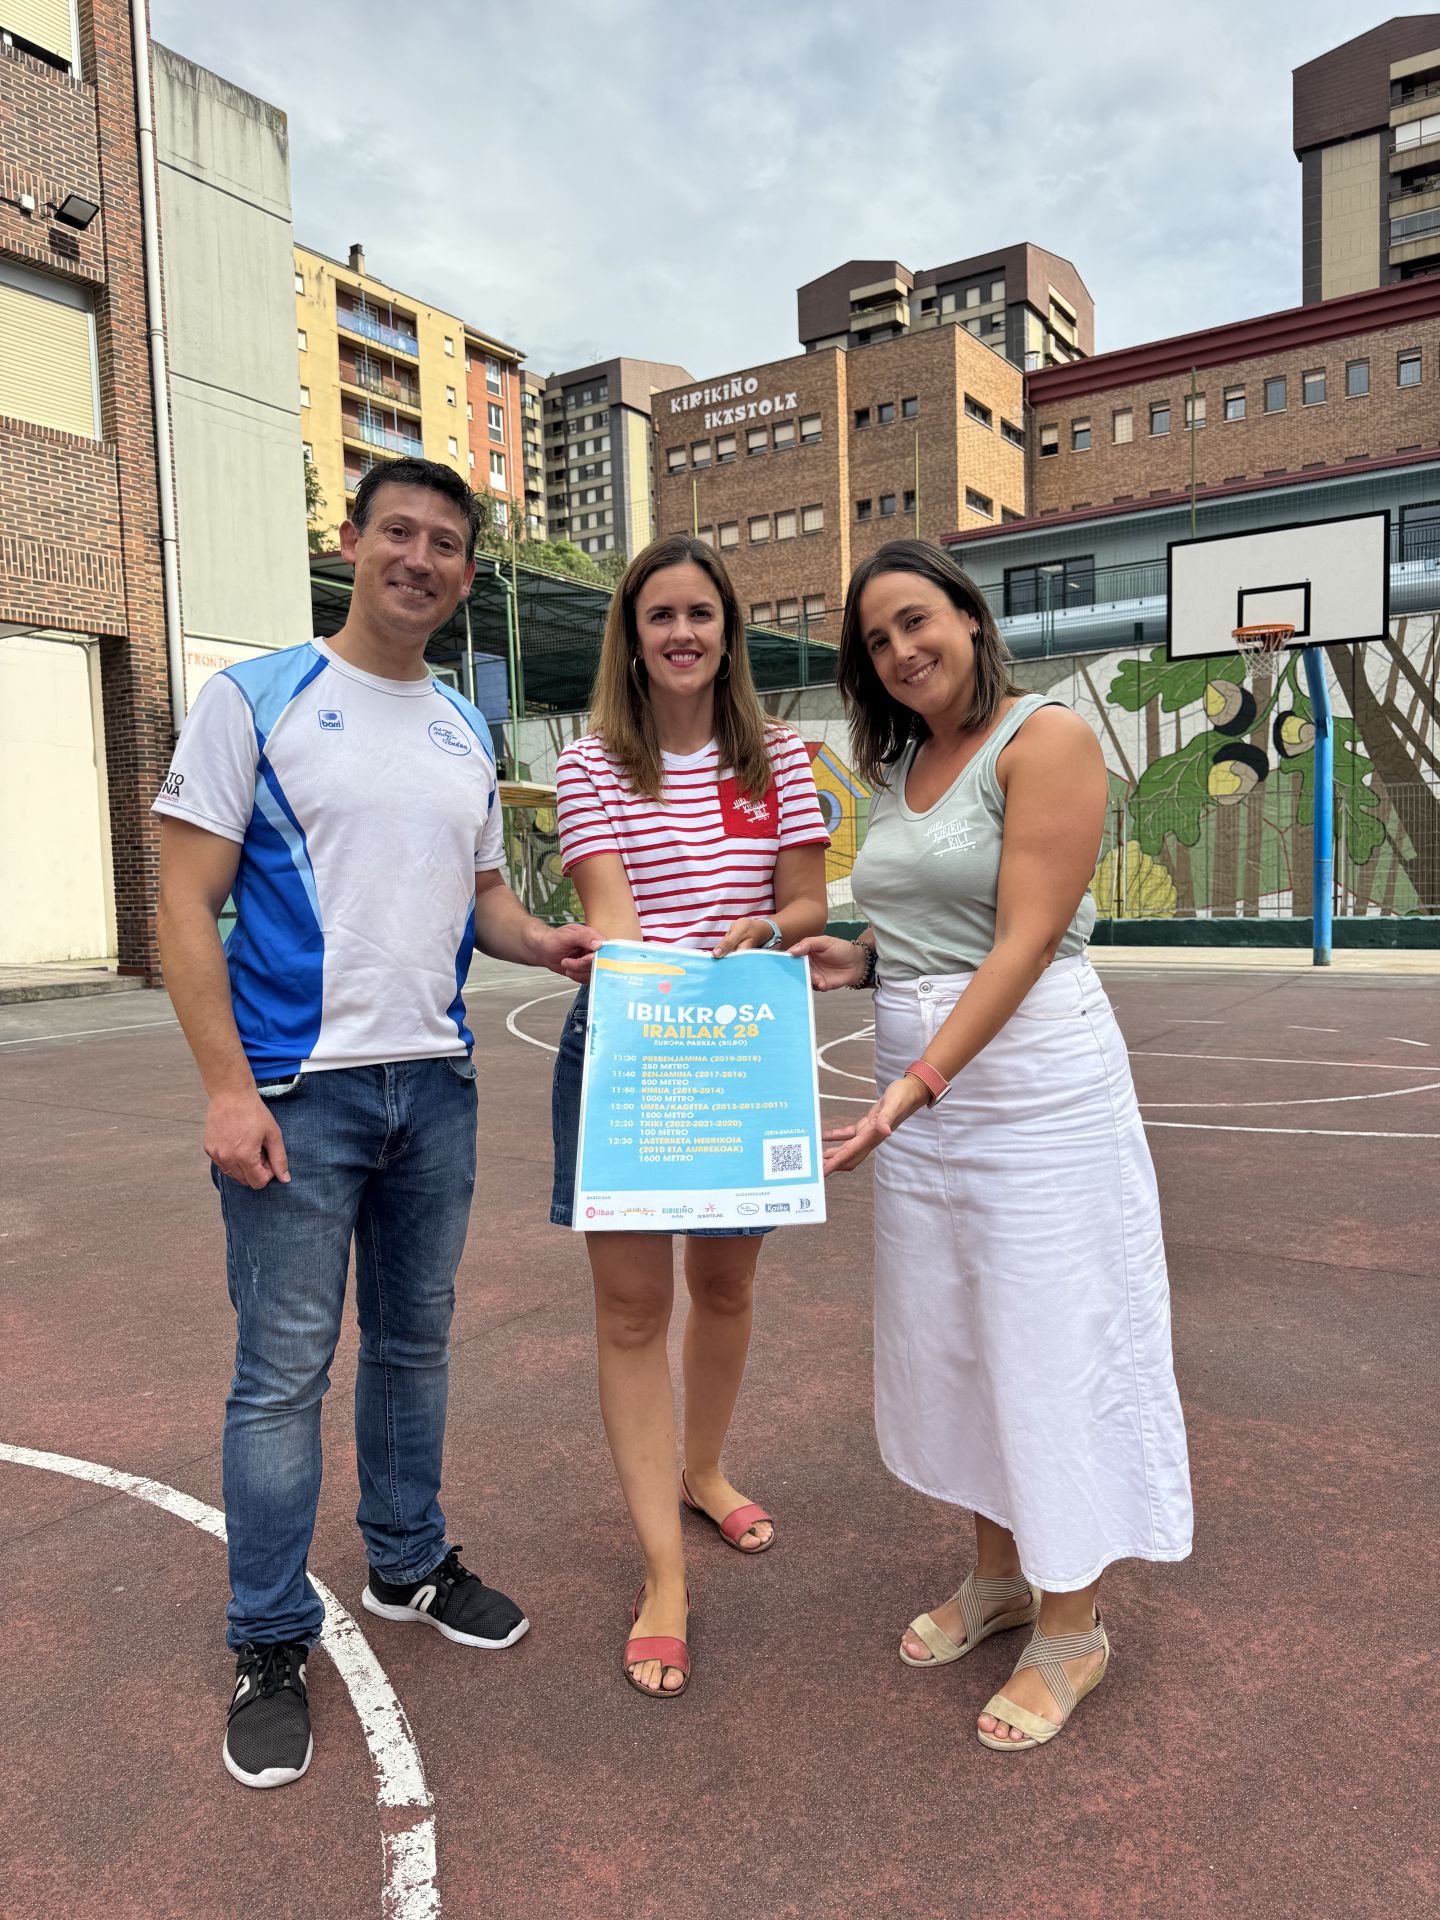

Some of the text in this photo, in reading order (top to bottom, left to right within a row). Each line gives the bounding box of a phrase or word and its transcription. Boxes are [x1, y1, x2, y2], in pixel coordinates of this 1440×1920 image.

[627, 1002, 775, 1025] IBILKROSA
[642, 1024, 760, 1039] IRAILAK 28
[718, 1039, 748, 1047] (BILBO)
[613, 1070, 636, 1078] 11:40
[663, 1154, 694, 1162] METRO
[586, 1206, 615, 1219] Bilbao
